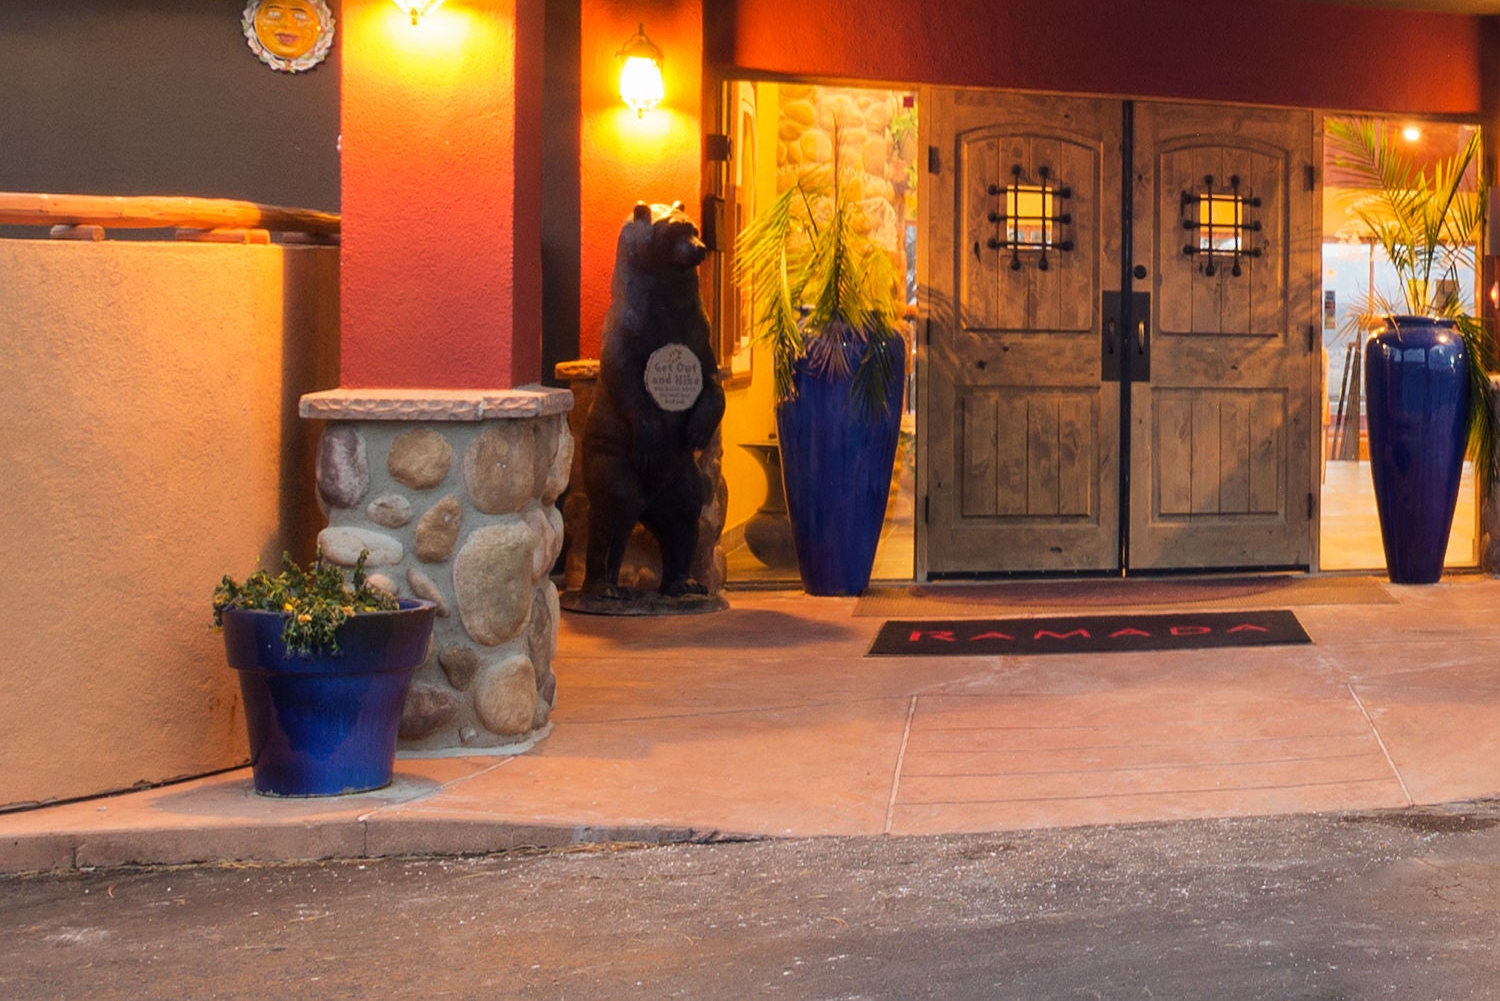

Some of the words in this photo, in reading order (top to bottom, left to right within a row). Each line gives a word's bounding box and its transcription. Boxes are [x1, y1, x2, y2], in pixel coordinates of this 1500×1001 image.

[654, 362, 673, 373] Get
[676, 362, 697, 373] Out
[652, 373, 672, 385] and
[675, 374, 700, 386] Hike
[908, 623, 1270, 642] RAMADA
